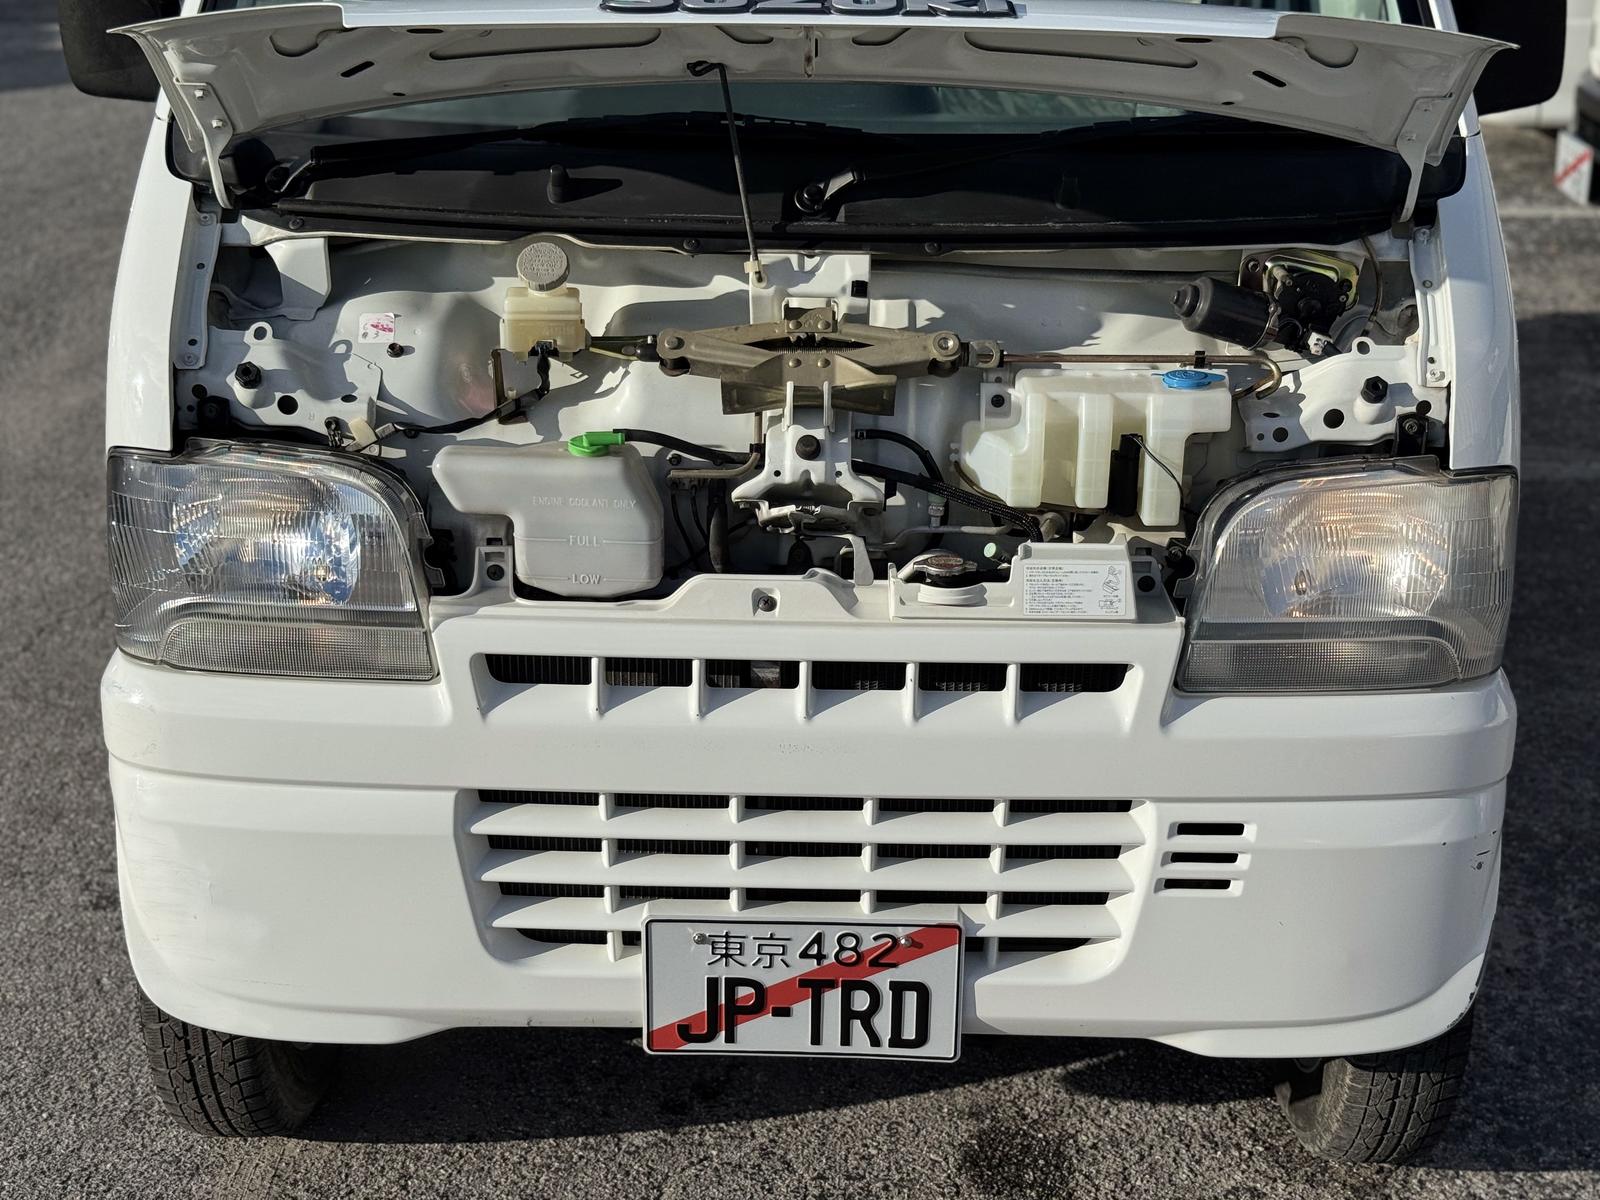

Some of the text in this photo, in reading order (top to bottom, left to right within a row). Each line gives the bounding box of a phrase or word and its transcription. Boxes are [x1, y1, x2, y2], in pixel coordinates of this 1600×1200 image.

[532, 495, 637, 510] ENGINE COOLANT ONLY
[568, 535, 601, 547] FULL
[571, 573, 602, 585] LOW
[706, 930, 899, 969] 東京 482
[676, 976, 931, 1049] JP-TRD
